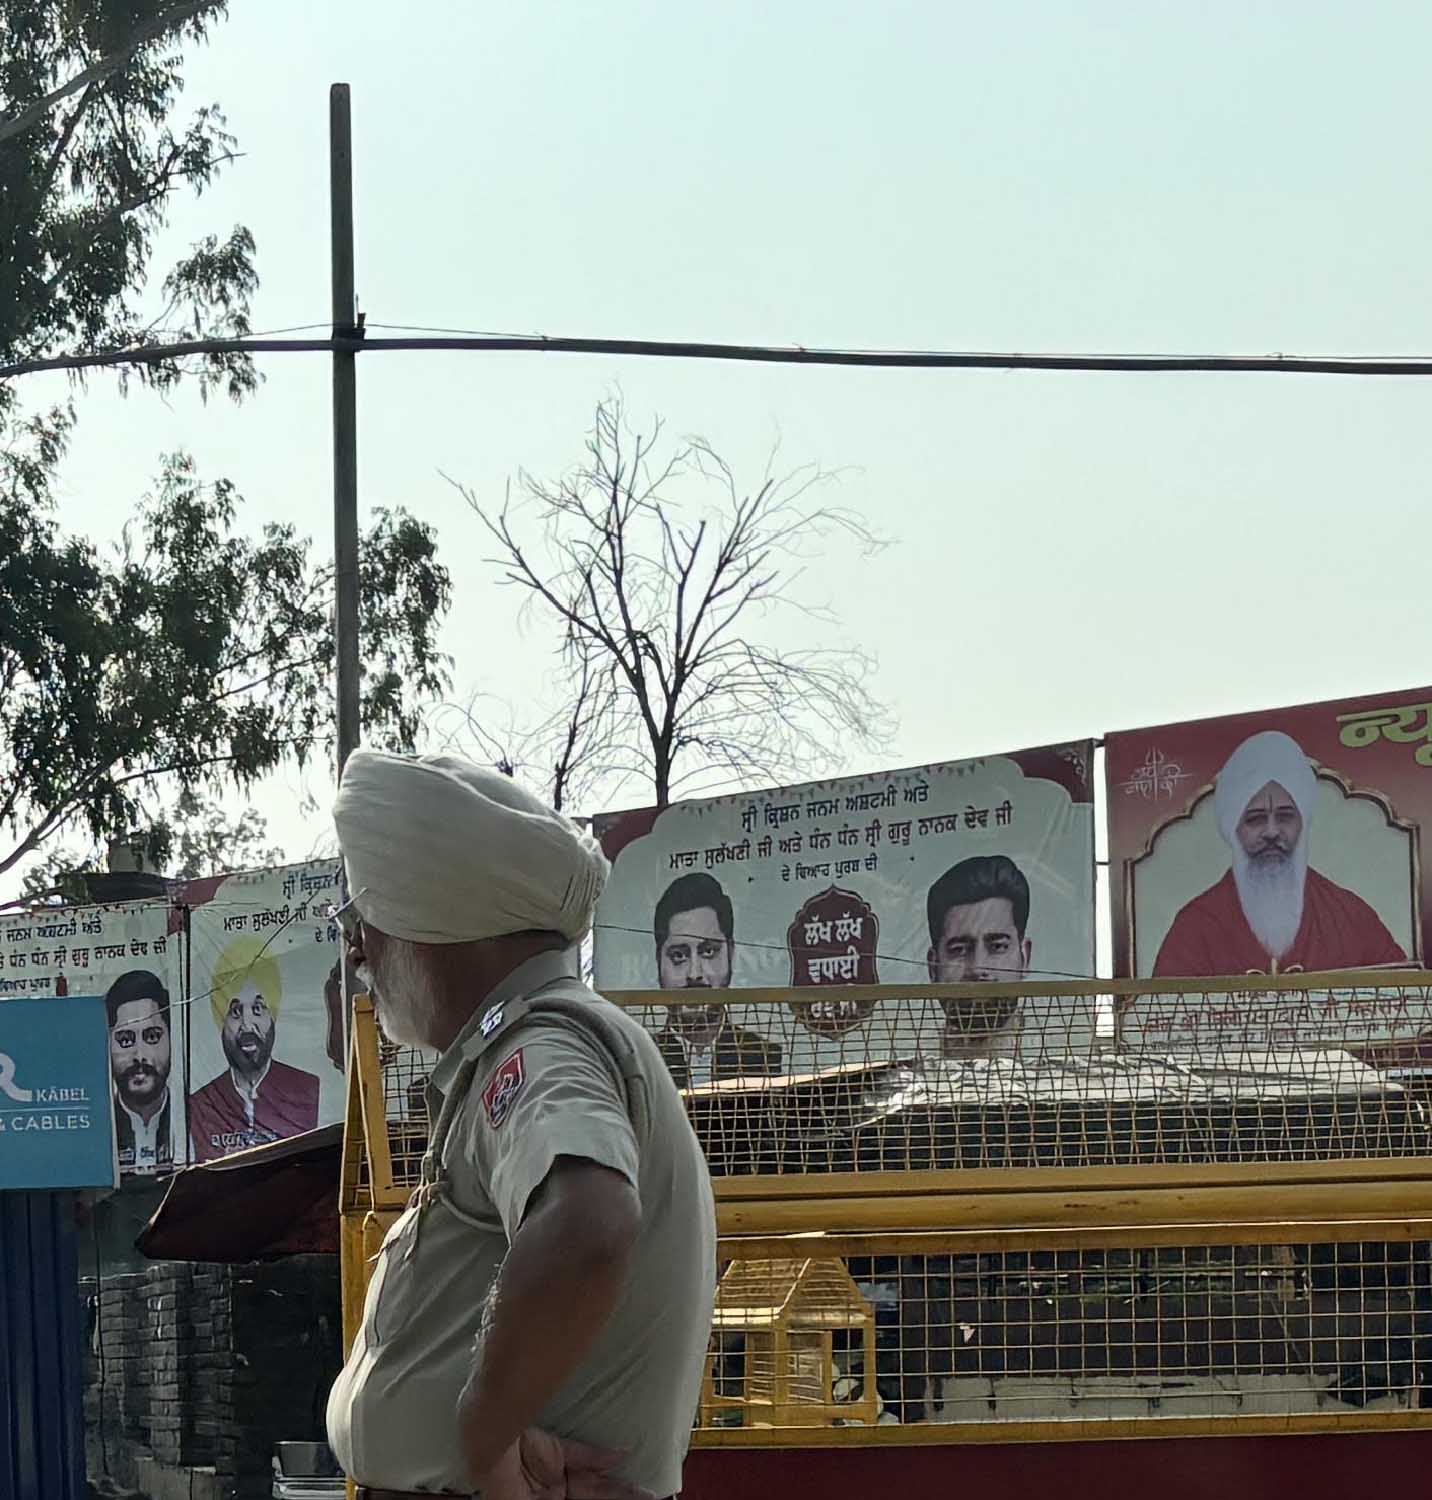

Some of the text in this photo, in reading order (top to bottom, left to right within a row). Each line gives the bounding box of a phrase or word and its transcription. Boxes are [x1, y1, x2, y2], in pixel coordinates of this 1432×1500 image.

[806, 798, 839, 820] ਜਨਮ
[904, 780, 929, 804] ਅਤੇ
[669, 851, 699, 869] ਮਾਤਾ
[758, 835, 773, 857] ਜੀ
[779, 831, 802, 854] ਅਤੇ
[918, 814, 958, 835] ਨਾਨਕ
[995, 800, 1013, 826] ਜੀ
[804, 911, 864, 945] ਲੱਖ ਲੱਖ
[11, 1114, 91, 1132] CABLES
